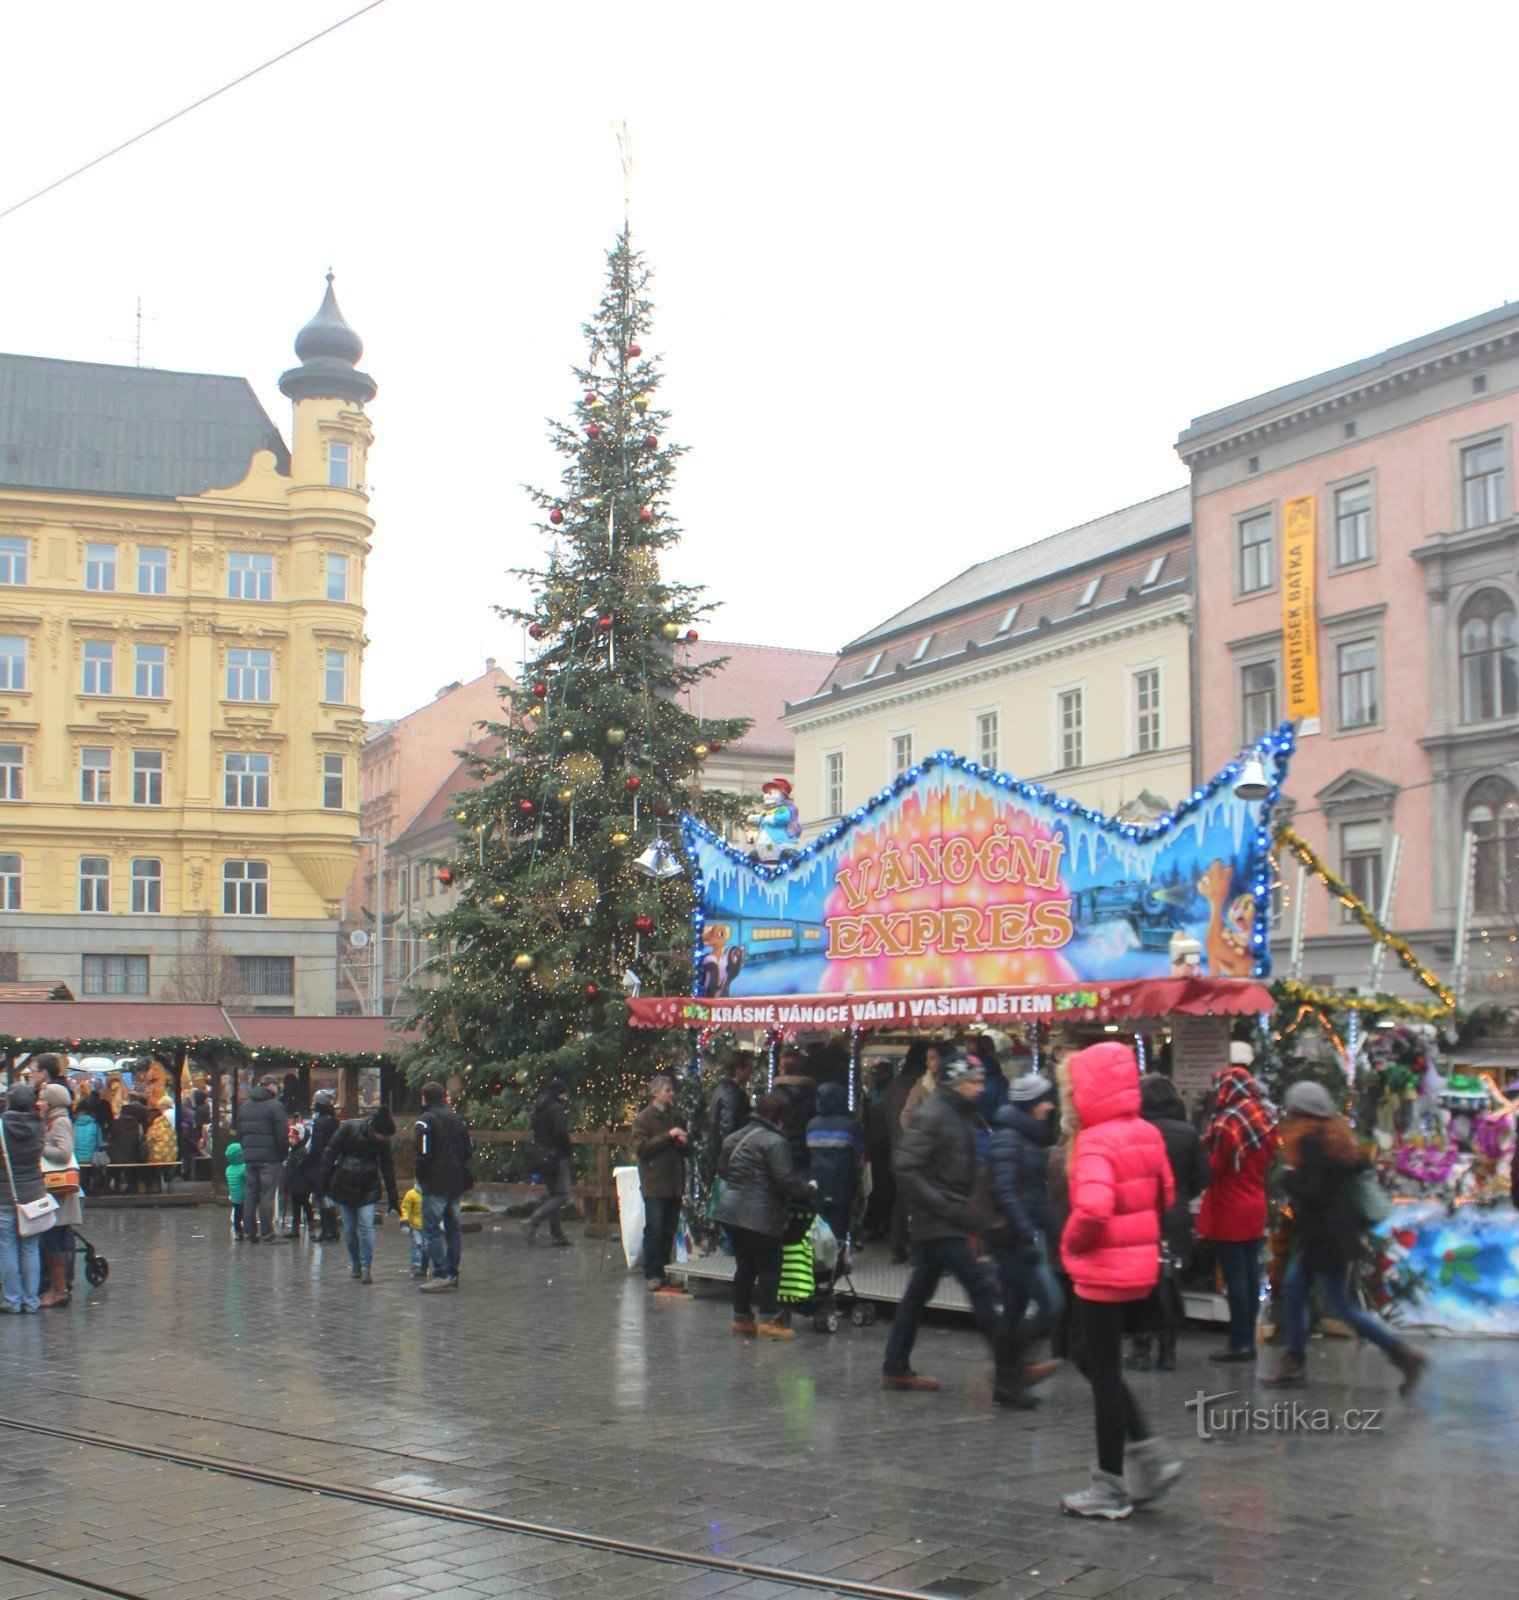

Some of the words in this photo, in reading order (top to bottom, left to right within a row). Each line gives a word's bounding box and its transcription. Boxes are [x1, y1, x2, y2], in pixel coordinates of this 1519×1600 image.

[1286, 544, 1303, 602] BAŤKA
[1287, 606, 1305, 704] FRANTIŠEK
[836, 825, 1065, 908] VÁNOČNÍ
[825, 899, 1073, 959] EXPRES
[711, 1005, 775, 1022] KRÁSNÉ
[777, 1005, 848, 1022] VÁNOCE
[852, 1001, 894, 1020] VÁM
[899, 1001, 905, 1018] I
[909, 996, 977, 1016] VAŠIM
[982, 993, 1052, 1014] DĚTEM
